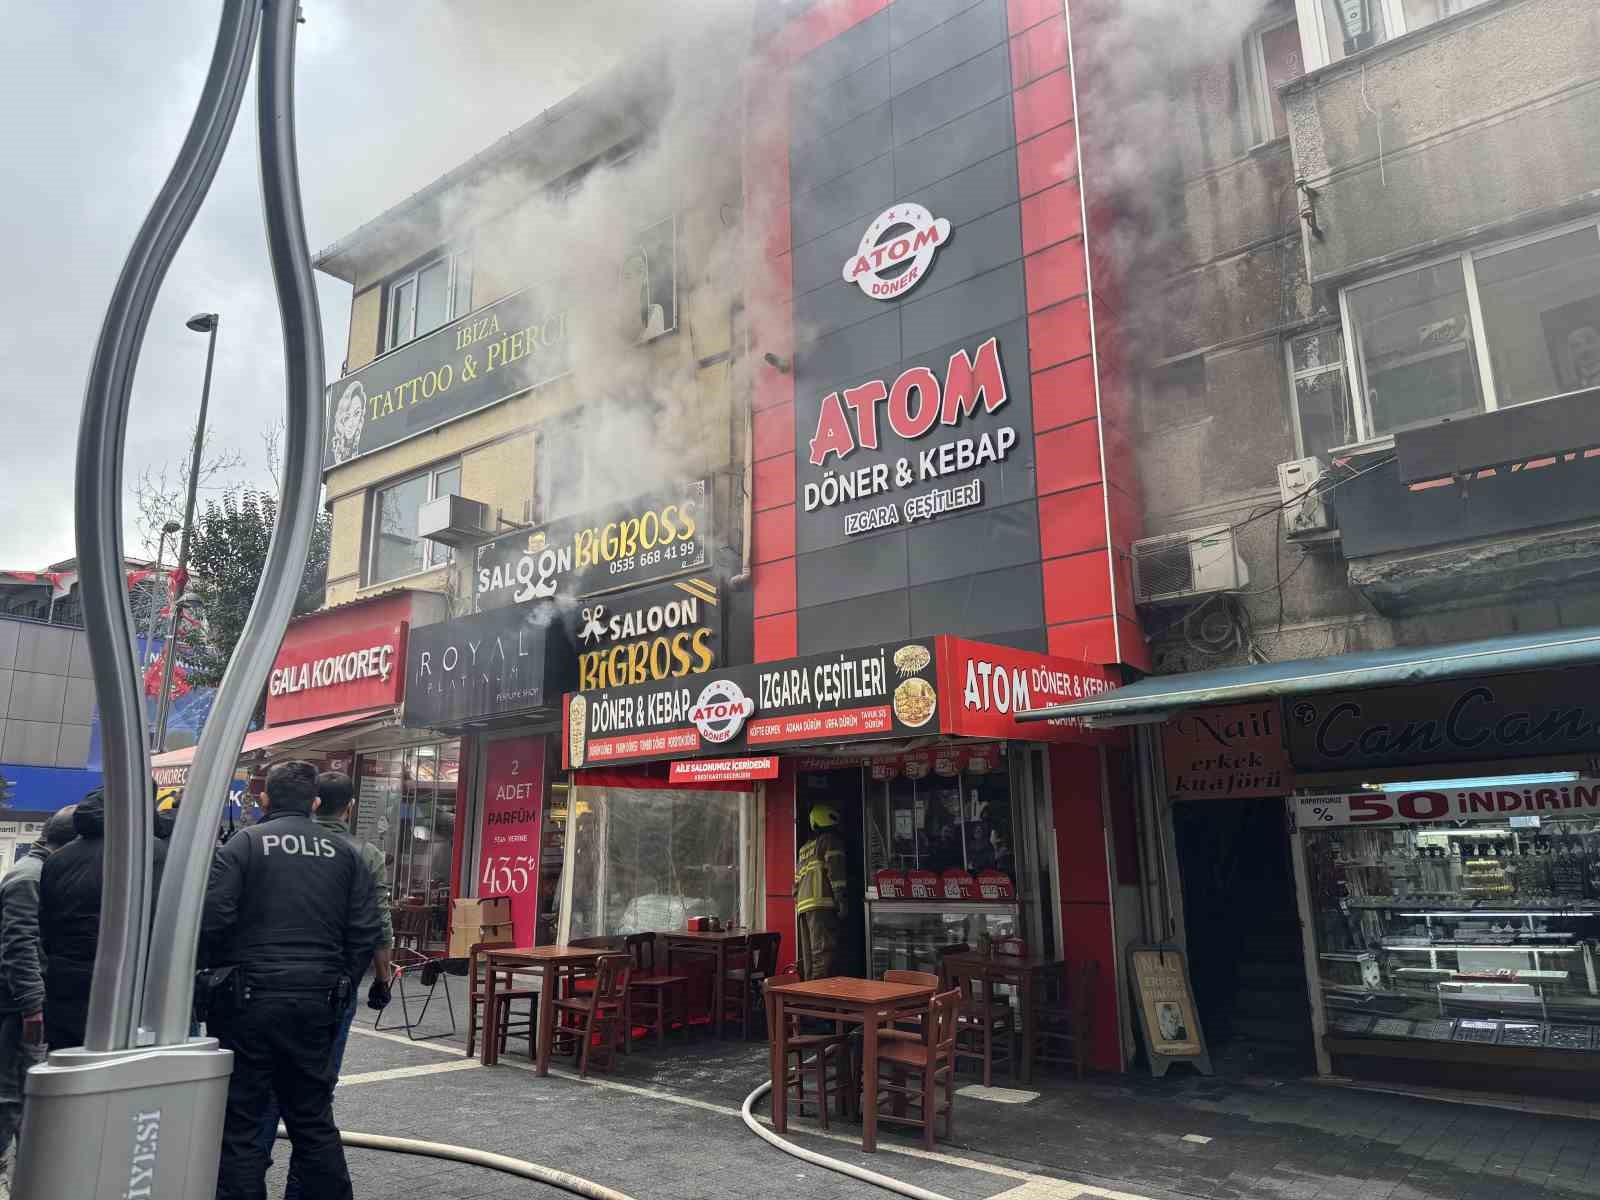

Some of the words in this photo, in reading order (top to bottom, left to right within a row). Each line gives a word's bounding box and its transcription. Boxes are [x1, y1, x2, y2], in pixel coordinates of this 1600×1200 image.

[852, 225, 939, 276] ATOM
[871, 267, 920, 296] DÖNER
[456, 313, 500, 351] İBİZA
[370, 364, 453, 420] TATTOO
[461, 354, 477, 383] &
[810, 336, 1007, 465] ATOM
[804, 462, 889, 511] DÖNER
[895, 457, 913, 487] &
[919, 426, 1017, 483] KEBAP
[845, 503, 899, 535] IZGARA
[904, 479, 981, 521] ÇEŞİTLERİ
[478, 545, 571, 593] SALOON
[609, 557, 635, 575] 0535
[640, 549, 661, 566] 668
[664, 546, 678, 561] 41
[680, 541, 695, 556] 99
[609, 597, 698, 641] SALOON
[270, 663, 310, 696] GALA
[312, 645, 394, 689] KOKOREÇ
[420, 631, 529, 676] ROYAL
[759, 667, 811, 709] IZGARA
[814, 648, 887, 709] ÇEŞİTLERİ
[964, 657, 1031, 714] ATOM
[1031, 665, 1072, 697] DÖNER
[1073, 675, 1081, 697] &
[592, 693, 634, 733] DÖNER
[636, 700, 645, 727] &
[648, 688, 691, 726] KEBAP
[693, 703, 744, 721] ATOM
[1180, 709, 1272, 747] Nail
[703, 729, 730, 742] DÖNER
[511, 760, 520, 776] 2
[676, 761, 690, 773] AİLE
[1192, 752, 1263, 771] erkek
[496, 783, 533, 801] ADET
[1313, 807, 1334, 822] %
[1349, 791, 1450, 823] 50
[488, 807, 536, 825] PARFÜM
